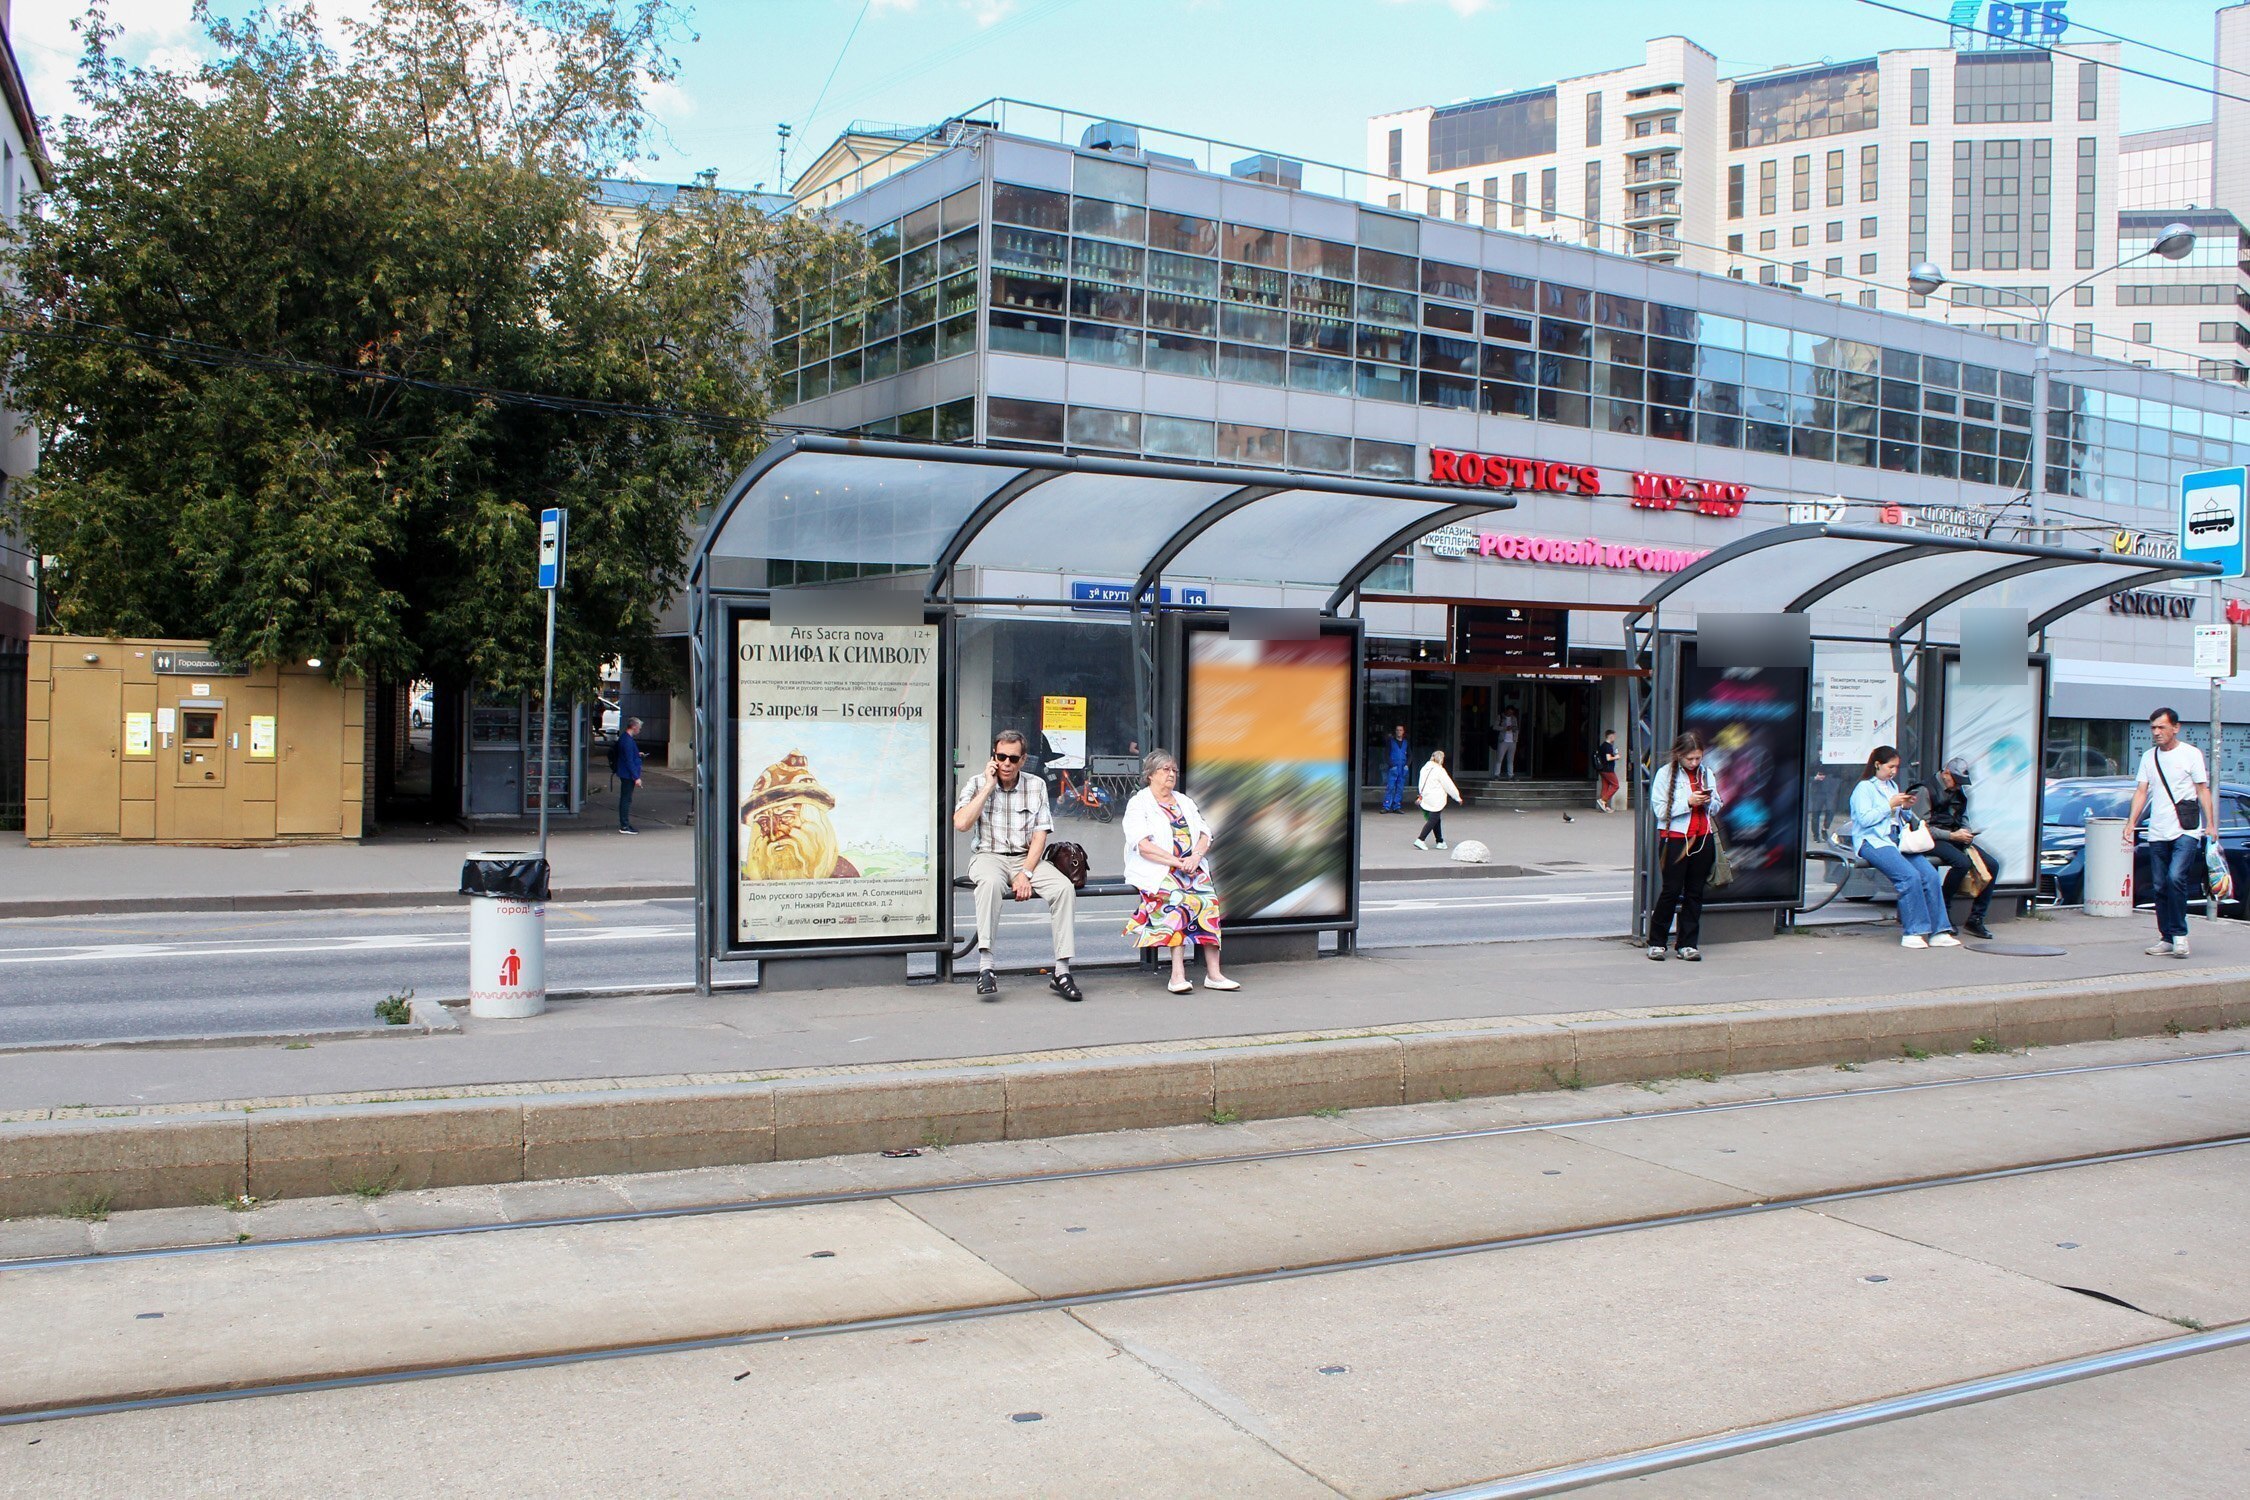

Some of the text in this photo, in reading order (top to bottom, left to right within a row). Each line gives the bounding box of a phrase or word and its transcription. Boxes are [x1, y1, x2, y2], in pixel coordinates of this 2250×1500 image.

[1988, 1, 2068, 37] ВТБ
[1431, 449, 1601, 494] ROSTIC'S
[1434, 525, 1473, 537] АГАЗИН
[1424, 533, 1480, 548] УКРЕПЛЕНИЯ
[1436, 545, 1466, 556] СЕМЬИ
[1479, 533, 1601, 566] РОЗОВЫЙ
[2108, 590, 2197, 618] SOKOLOV
[790, 627, 884, 641] Ars Sacra nova
[913, 630, 931, 638] 12+
[740, 644, 931, 665] ОТ МИФА К СИМВОЛУ
[178, 659, 221, 668] Городской
[749, 702, 764, 717] 25
[767, 703, 818, 720] апреля
[842, 703, 854, 717] 15
[857, 702, 923, 720] сентября
[749, 892, 767, 901] Дом
[769, 893, 803, 901] русского
[805, 890, 845, 900] зарубежья
[497, 904, 530, 915] город!
[780, 903, 793, 911] ул.
[794, 901, 825, 910] Нижняя
